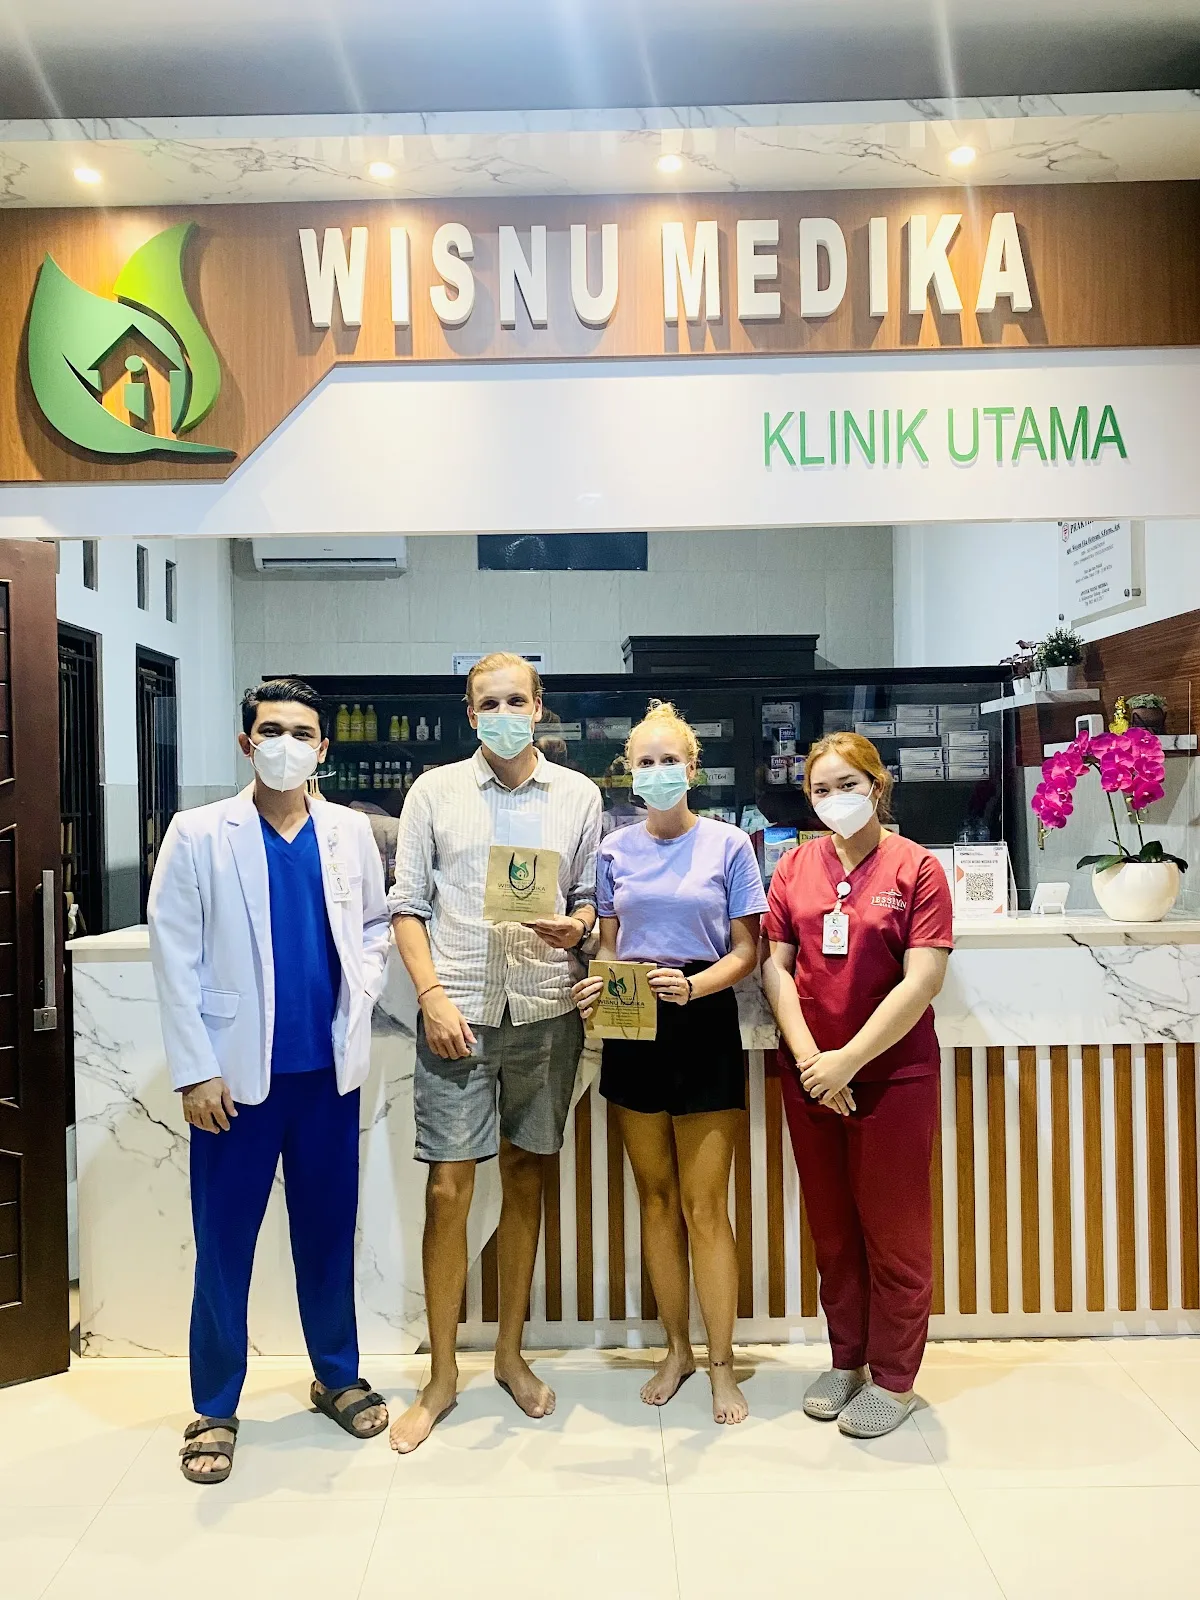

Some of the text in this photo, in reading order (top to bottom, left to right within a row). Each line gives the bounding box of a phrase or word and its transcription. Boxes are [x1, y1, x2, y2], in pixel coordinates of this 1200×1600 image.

[299, 211, 1033, 330] WISNU MEDIKA
[763, 404, 1128, 467] KLINIK UTAMA
